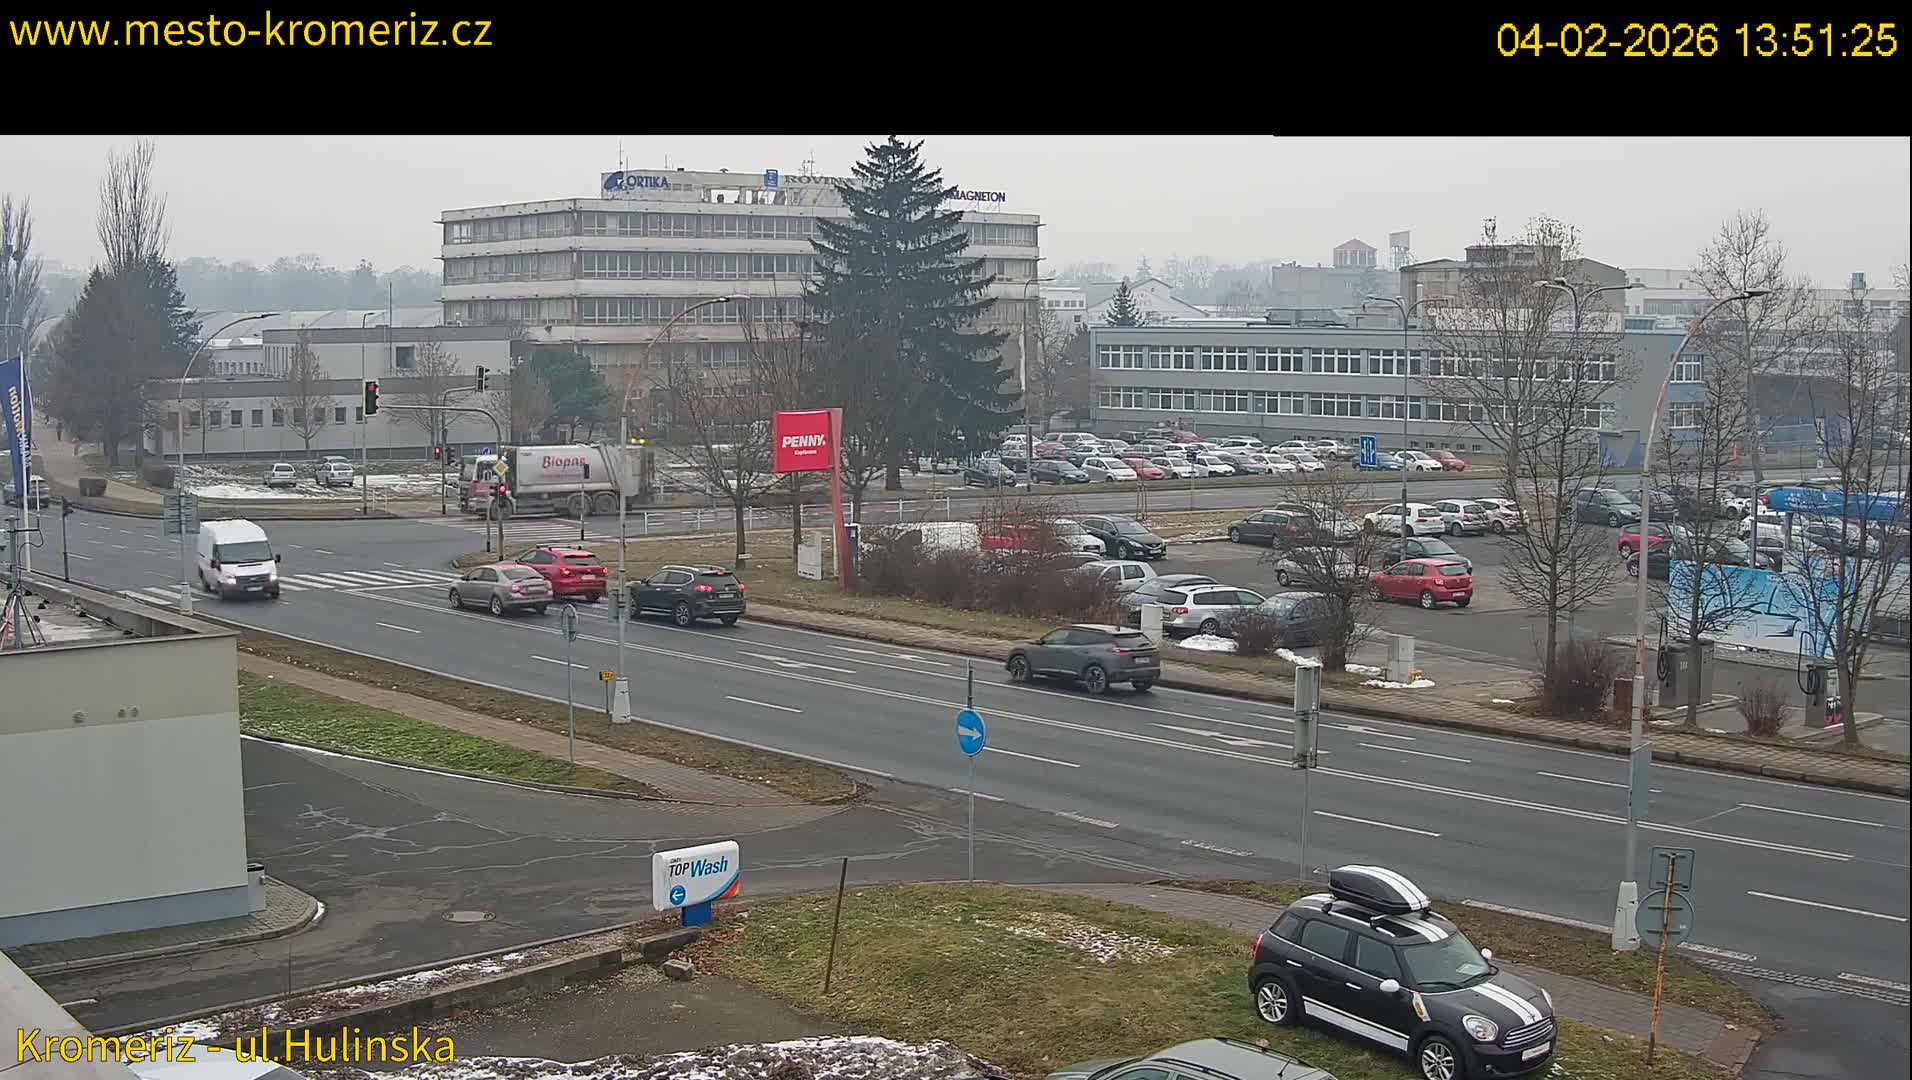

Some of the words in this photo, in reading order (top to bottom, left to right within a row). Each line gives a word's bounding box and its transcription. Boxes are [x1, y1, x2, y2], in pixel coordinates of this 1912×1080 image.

[627, 175, 671, 188] ORTIKA
[669, 862, 690, 878] TOP
[690, 855, 728, 878] Wash
